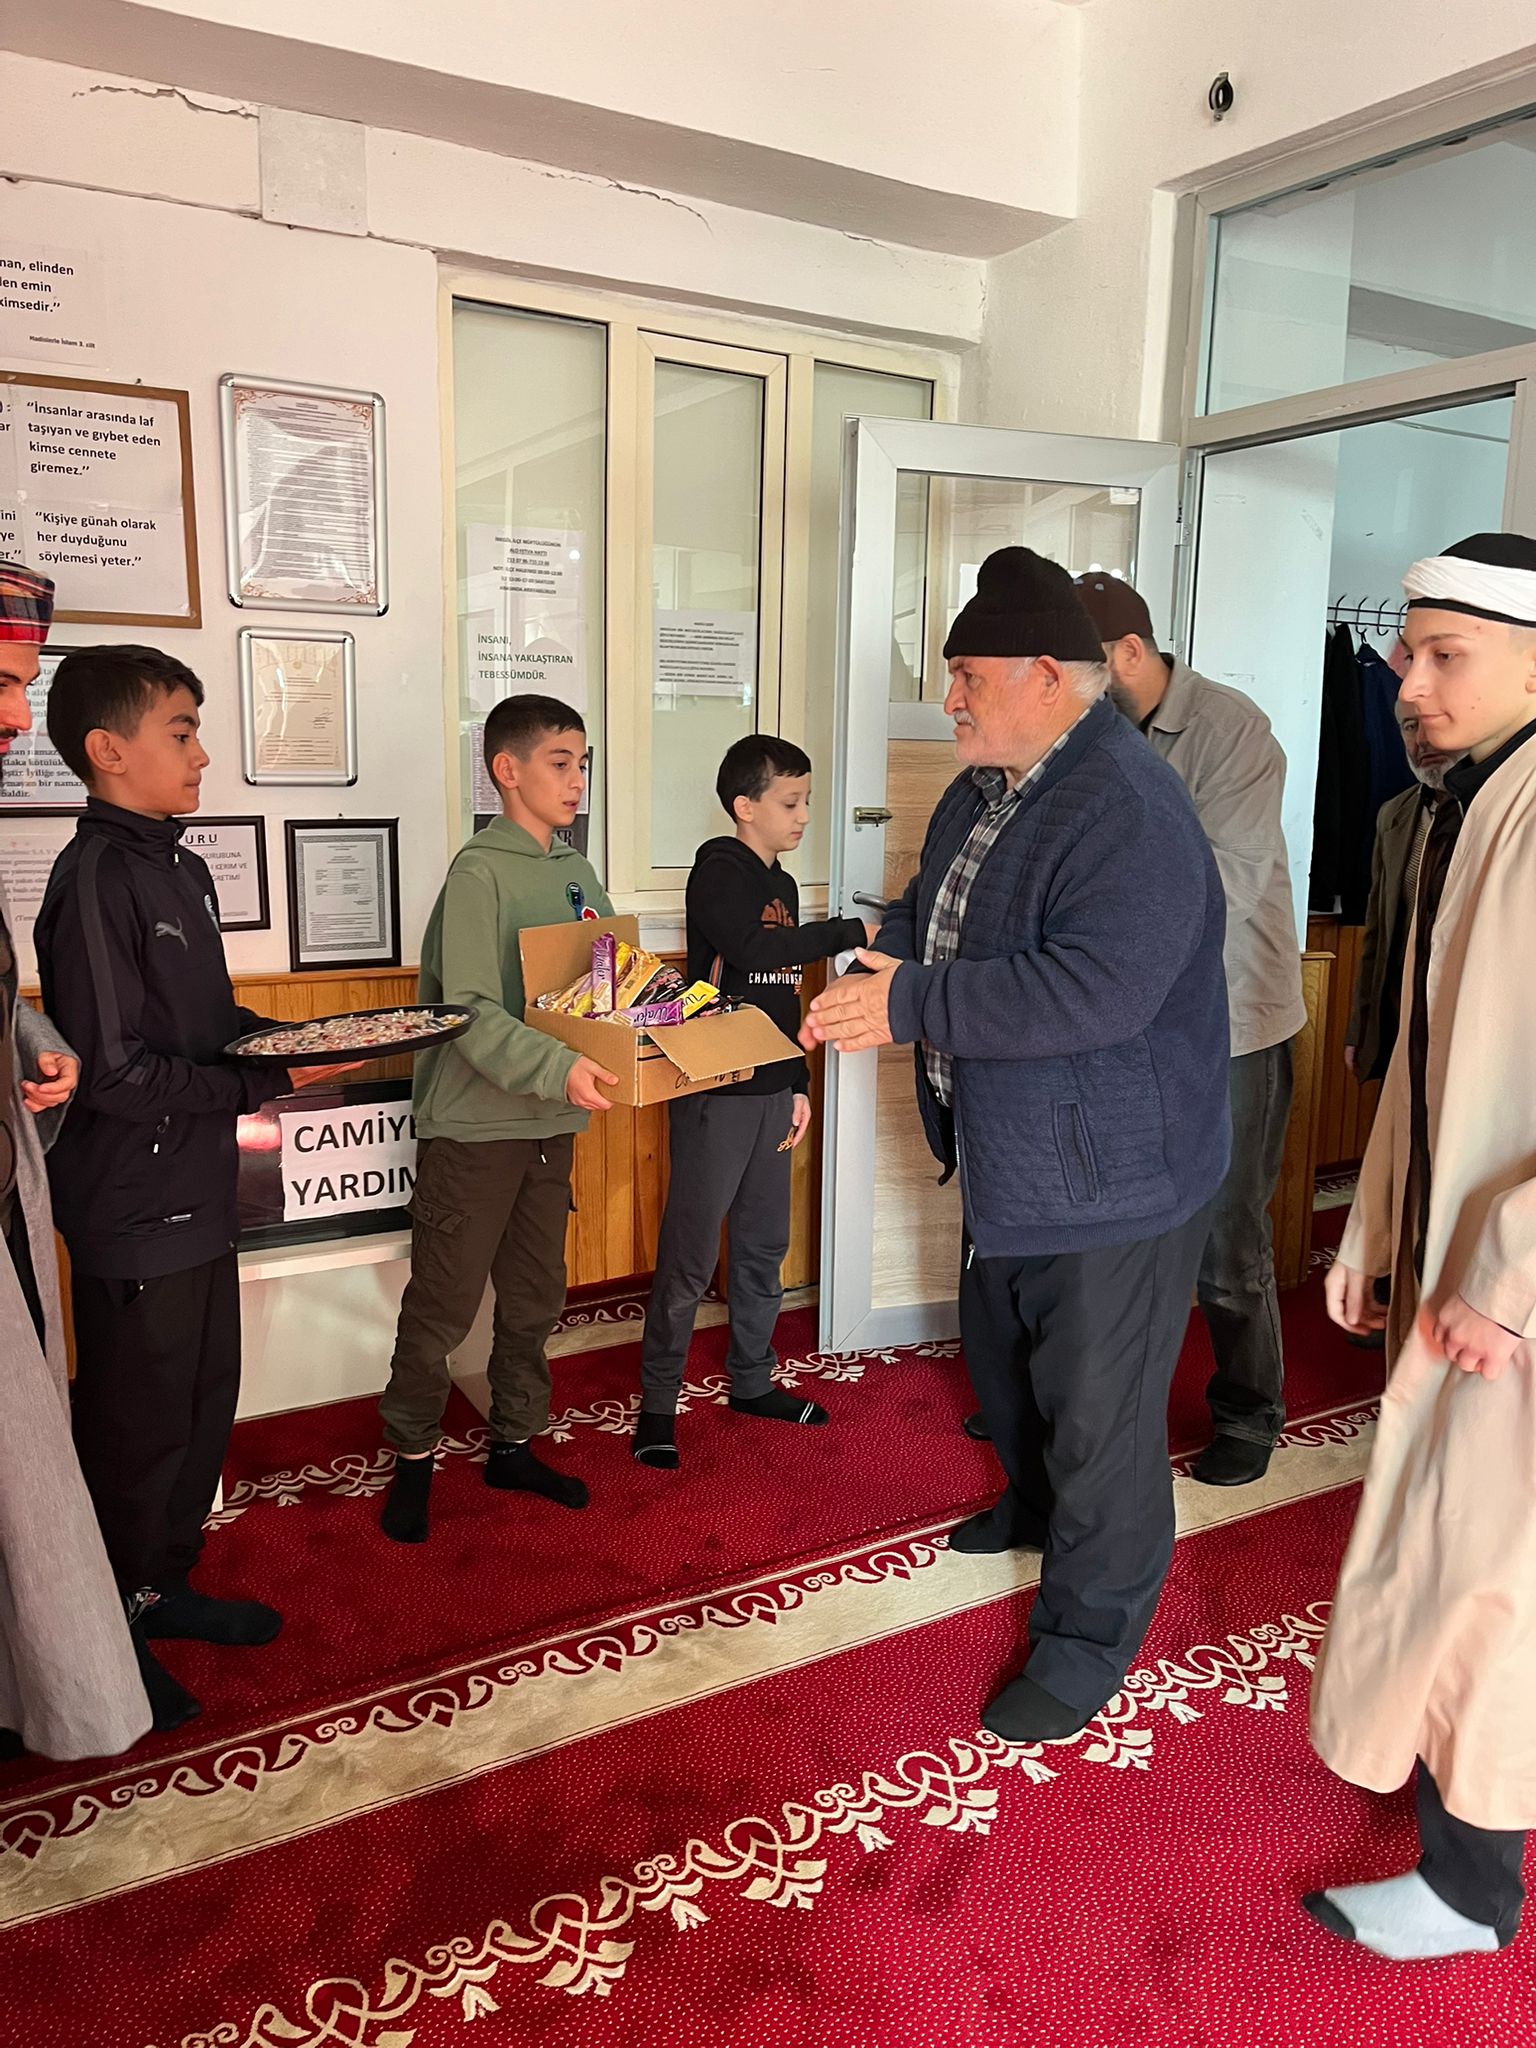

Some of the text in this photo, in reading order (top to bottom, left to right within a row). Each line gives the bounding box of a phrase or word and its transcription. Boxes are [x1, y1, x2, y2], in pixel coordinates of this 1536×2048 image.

[29, 260, 74, 276] elinden
[21, 281, 52, 293] emin
[86, 409, 136, 426] arasında
[139, 415, 155, 428] laf
[28, 422, 161, 447] taşıyan ve gıybet eden
[29, 441, 117, 460] kimse cennete
[81, 515, 118, 528] günah
[121, 518, 157, 531] olarak
[37, 530, 128, 548] her duyduğunu
[38, 550, 98, 565] söylemesi
[477, 633, 512, 645] İNSANI,
[478, 651, 573, 664] İNSANA YAKLAŞTIRAN
[479, 669, 547, 680] TEBESSÜMDÜR.
